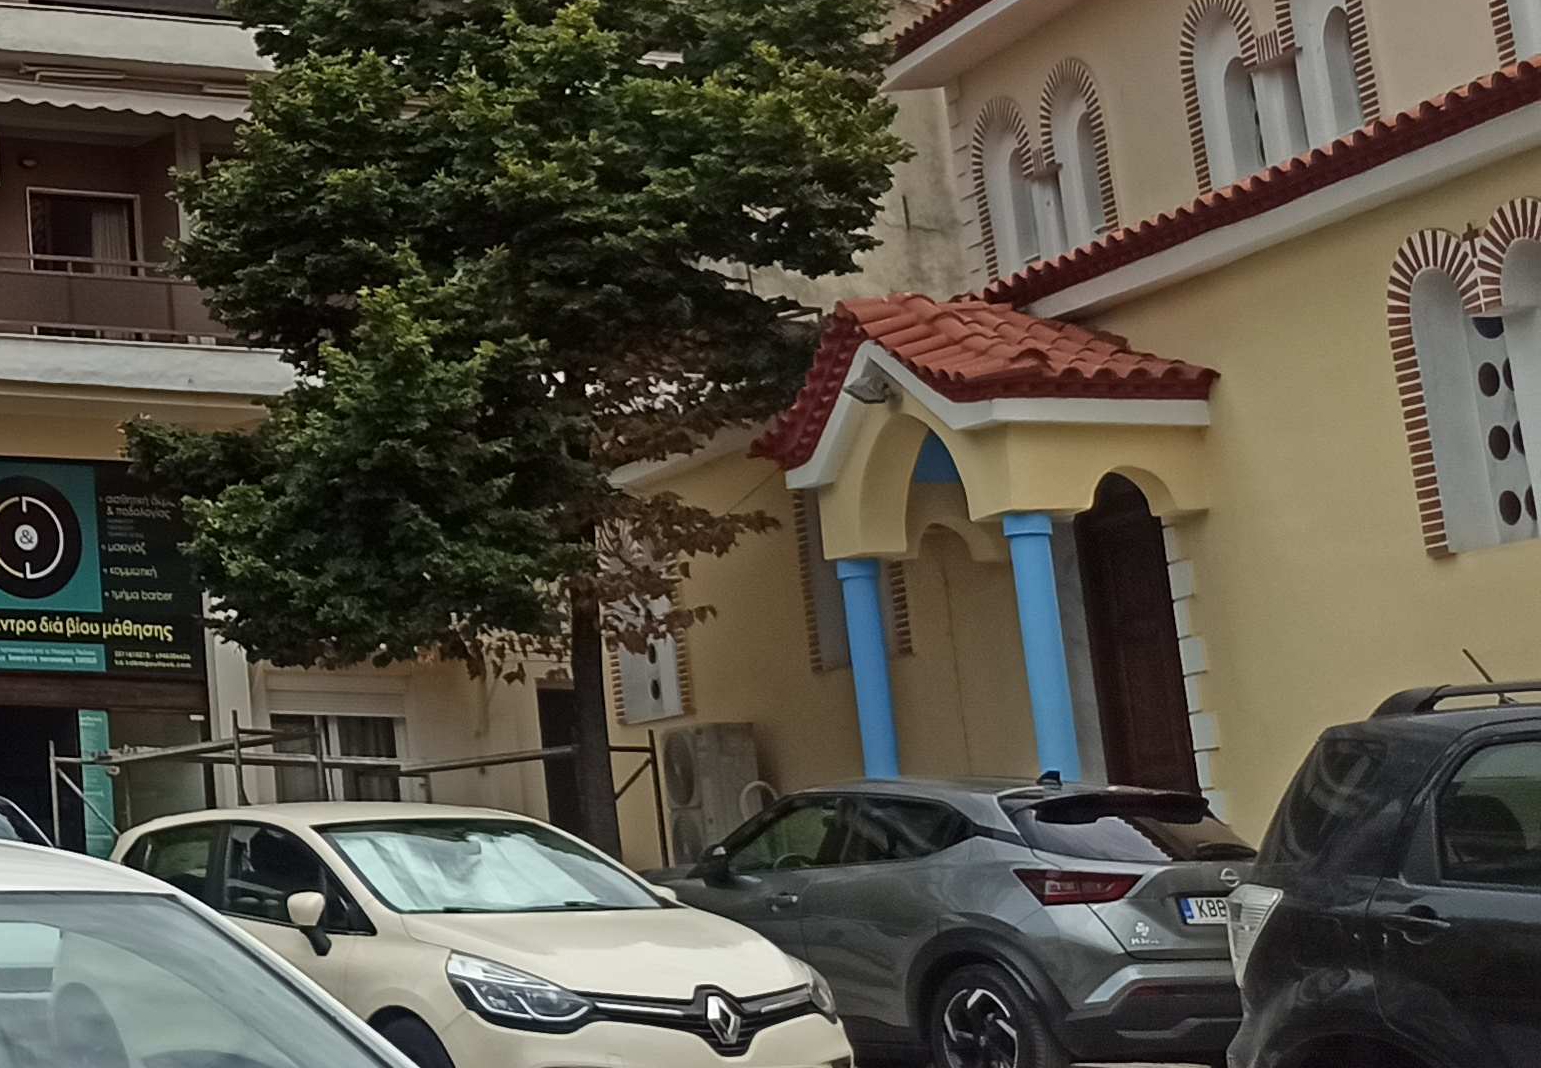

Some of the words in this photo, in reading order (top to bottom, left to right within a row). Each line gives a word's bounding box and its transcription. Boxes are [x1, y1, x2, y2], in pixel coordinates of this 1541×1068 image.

[40, 615, 64, 634] διά
[66, 617, 100, 638] βίου
[103, 618, 174, 642] μάθησης
